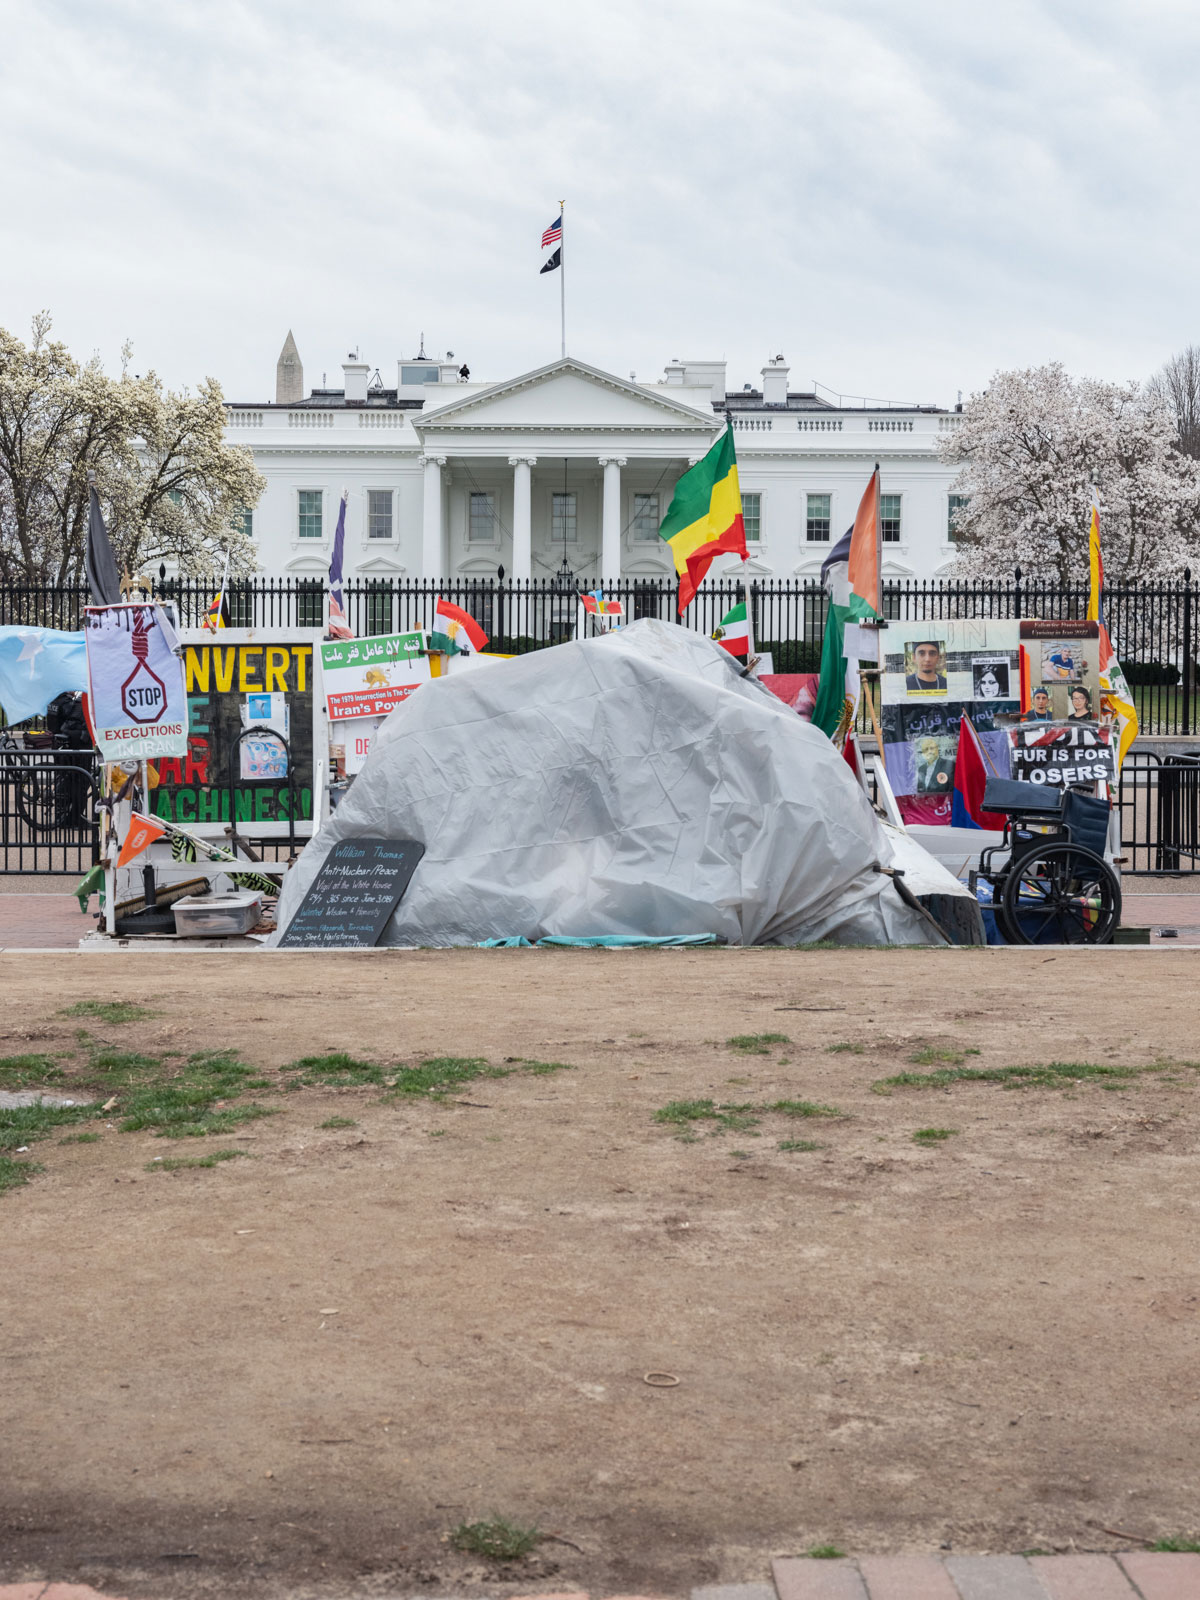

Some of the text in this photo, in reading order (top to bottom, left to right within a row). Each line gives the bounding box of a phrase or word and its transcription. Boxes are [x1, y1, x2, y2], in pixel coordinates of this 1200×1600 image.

[404, 636, 420, 651] فتنه
[325, 647, 343, 662] ملت
[346, 644, 360, 663] فقر
[362, 643, 384, 661] عامل
[128, 687, 161, 707] STOP
[341, 695, 354, 703] 1979
[354, 691, 386, 702] Insurrection
[393, 689, 403, 697] The
[333, 703, 371, 716] Iran's
[104, 724, 182, 741] EXECUTIONS
[118, 739, 175, 757] IN IRAN
[1013, 748, 1111, 762] FUR IS FOR
[148, 737, 211, 784] AR
[1018, 764, 1108, 784] LOSERS
[335, 846, 405, 859] William Thomas
[352, 879, 370, 890] White
[372, 879, 393, 889] House
[342, 894, 358, 903] since
[360, 892, 376, 903] June
